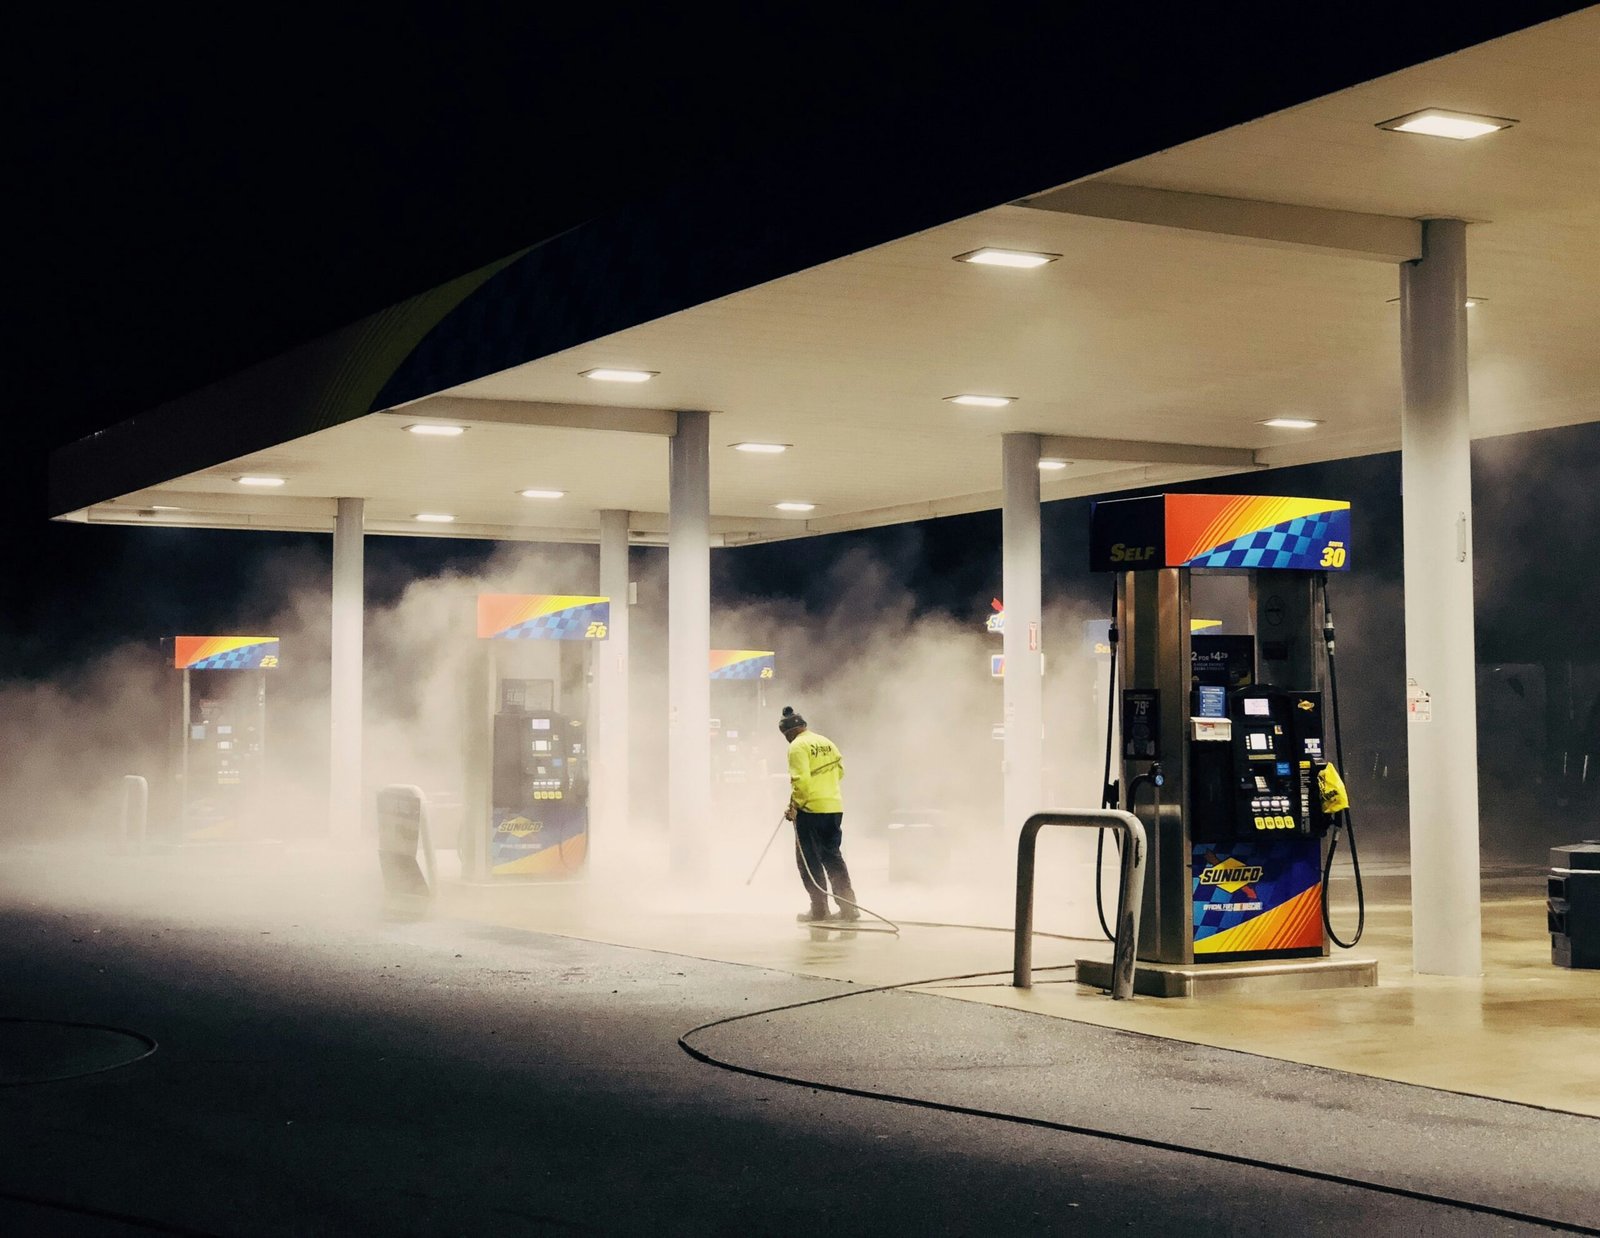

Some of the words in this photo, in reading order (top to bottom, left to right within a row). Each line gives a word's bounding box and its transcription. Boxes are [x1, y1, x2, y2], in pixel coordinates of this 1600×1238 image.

[1109, 543, 1156, 562] SELF
[1320, 546, 1346, 568] 30
[584, 625, 608, 639] 26
[259, 657, 278, 667] 22
[1191, 651, 1198, 661] 2
[500, 822, 542, 832] SUNOCO
[1201, 867, 1262, 884] SUNOCO
